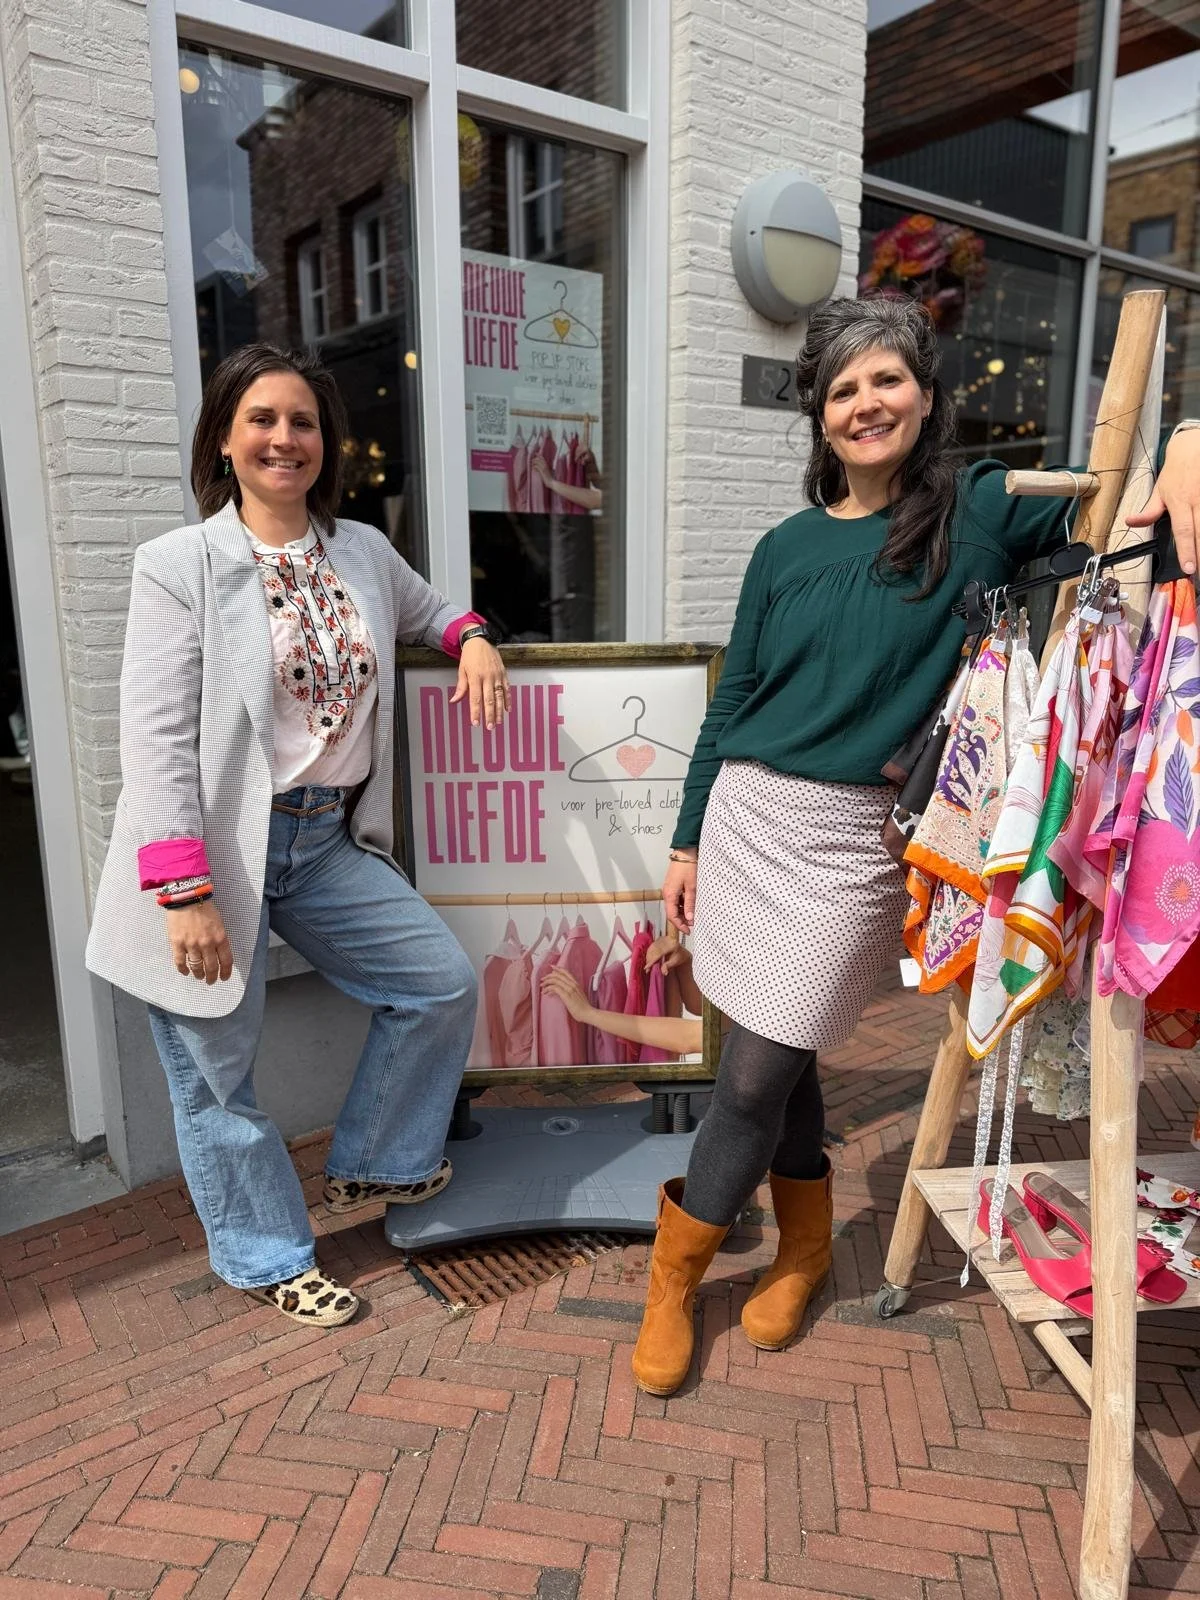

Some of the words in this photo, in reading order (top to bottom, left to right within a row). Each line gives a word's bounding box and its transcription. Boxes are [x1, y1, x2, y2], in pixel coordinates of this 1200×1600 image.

[463, 261, 526, 320] NIEUWE
[464, 315, 519, 371] LIEFDE
[758, 365, 790, 402] 52
[425, 780, 547, 864] LIEFDE
[561, 800, 585, 811] voor
[595, 788, 652, 820] pre-loved
[659, 787, 682, 809] clot
[608, 814, 622, 836] &
[631, 813, 663, 836] shoes
